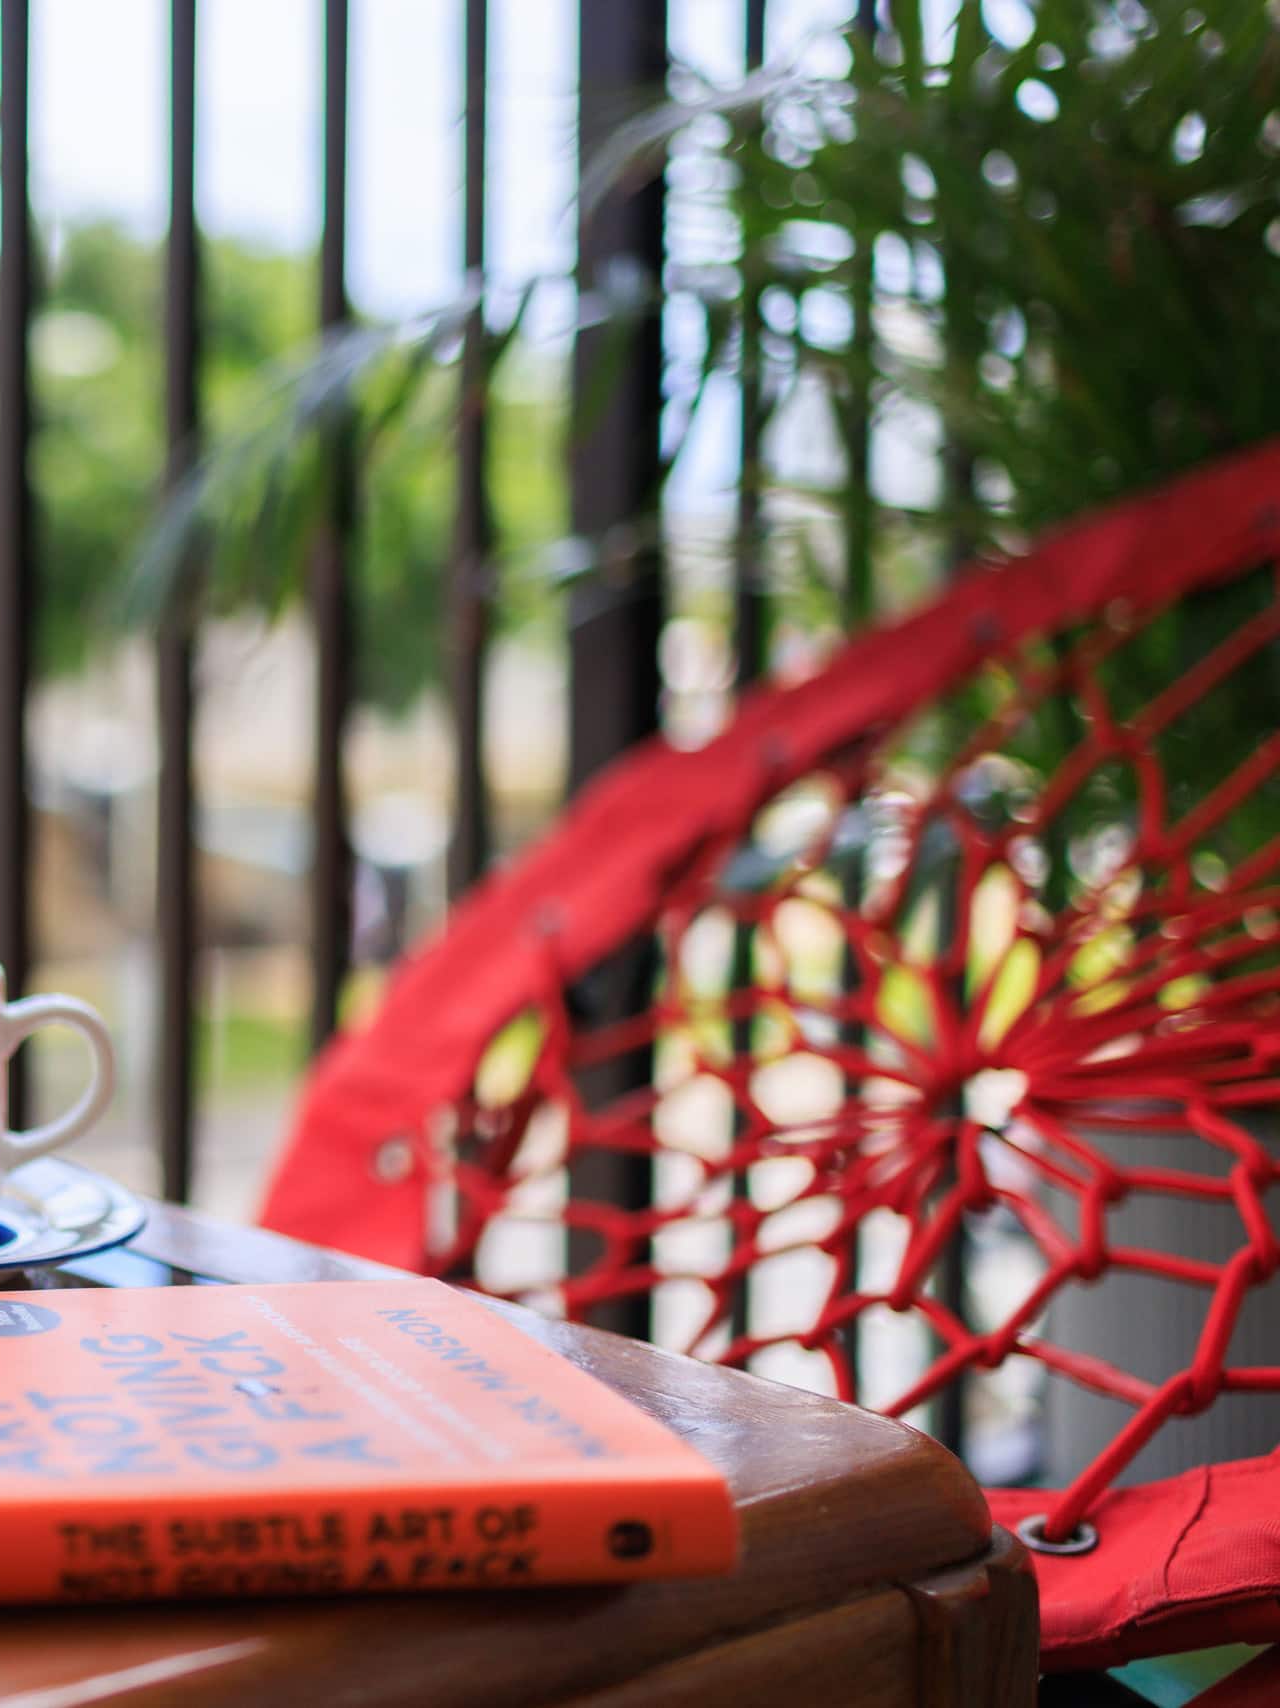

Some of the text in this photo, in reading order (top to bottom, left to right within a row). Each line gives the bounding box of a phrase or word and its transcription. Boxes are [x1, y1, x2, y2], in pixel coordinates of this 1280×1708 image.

[376, 1308, 528, 1391] MANSON
[24, 1391, 178, 1475] NOT
[78, 1334, 282, 1471] GIVING
[294, 1434, 400, 1468] A
[58, 1504, 539, 1558] THE SUBTLE ART OF
